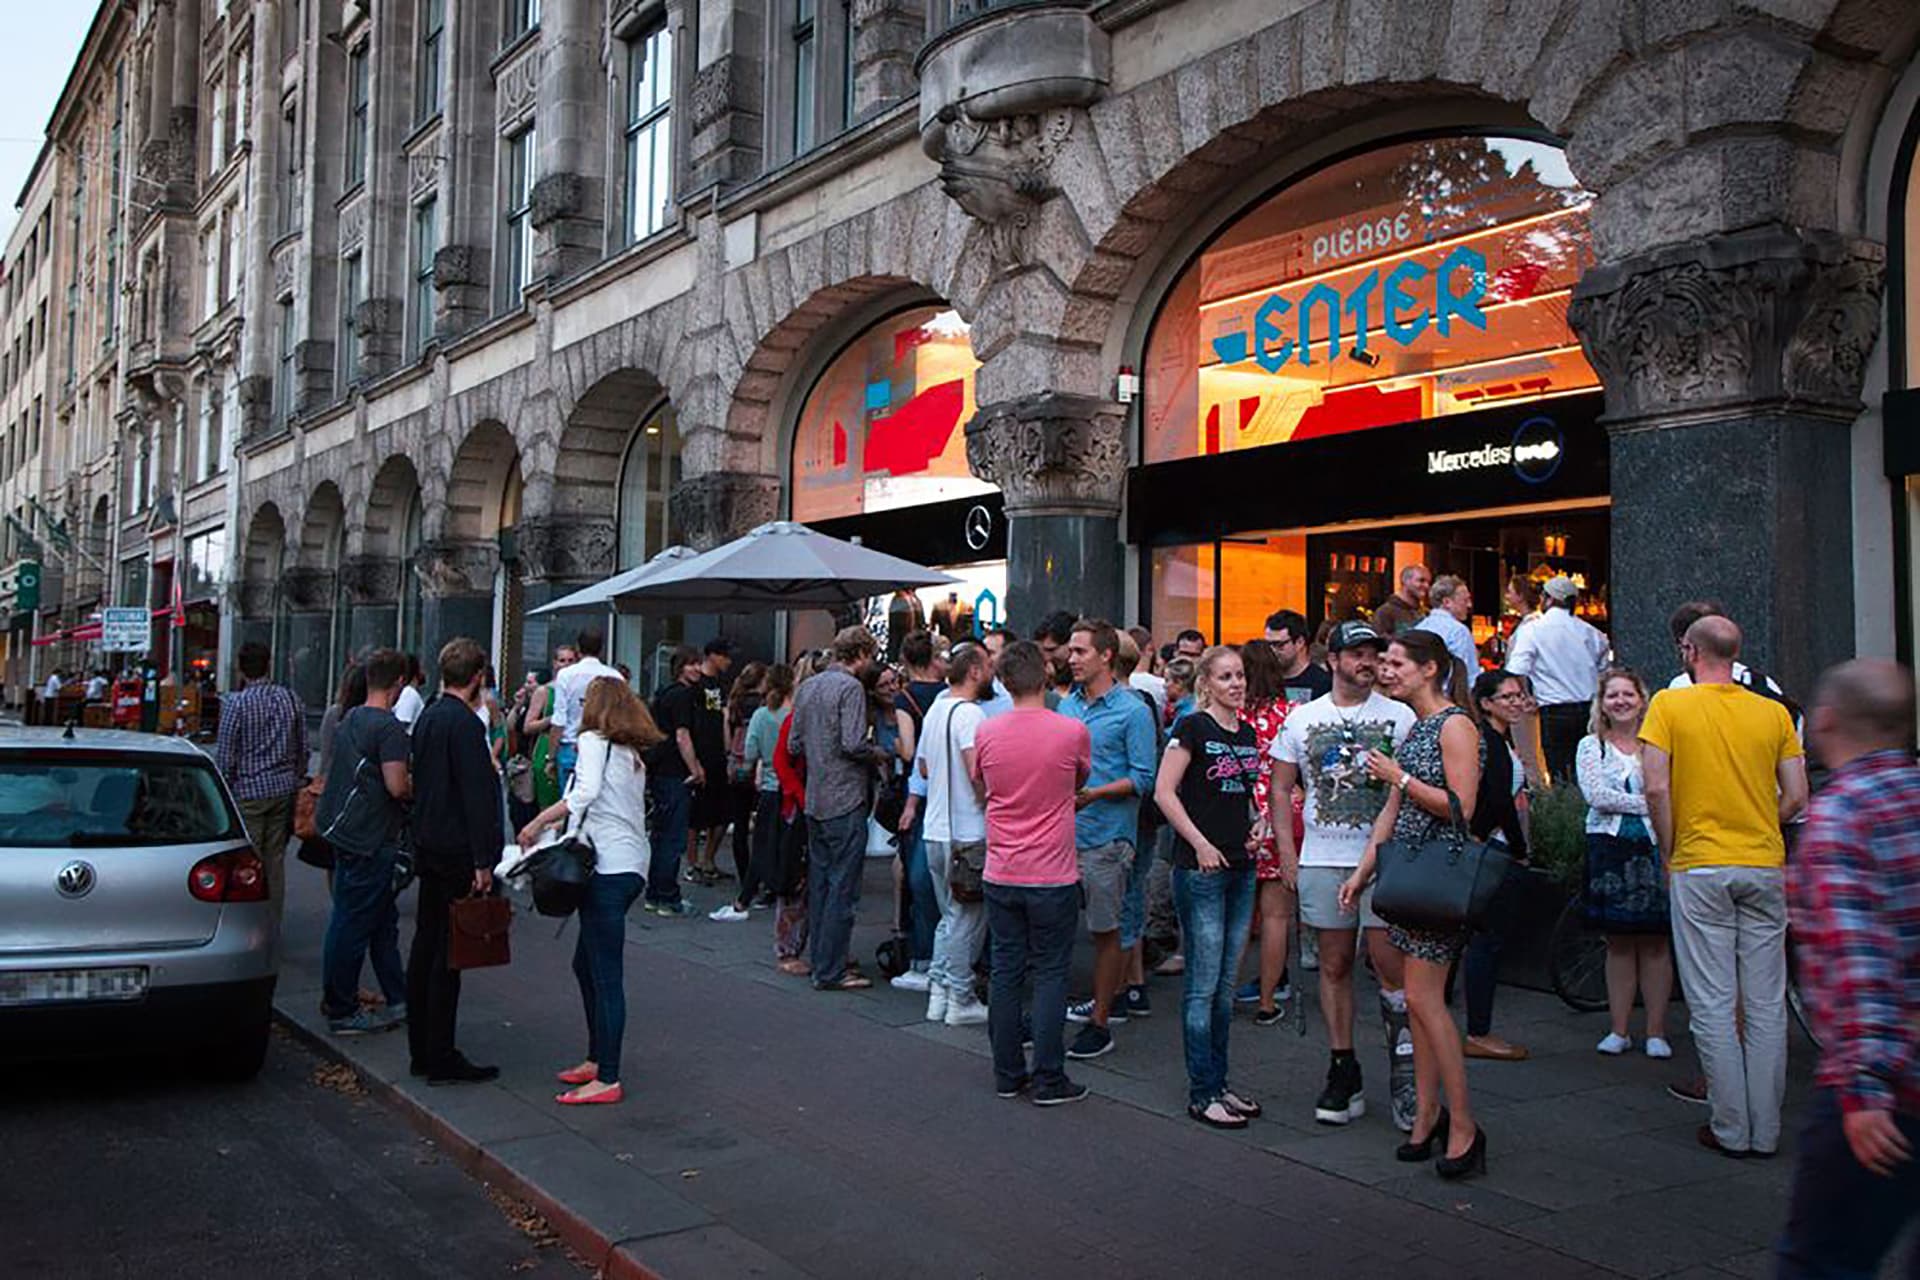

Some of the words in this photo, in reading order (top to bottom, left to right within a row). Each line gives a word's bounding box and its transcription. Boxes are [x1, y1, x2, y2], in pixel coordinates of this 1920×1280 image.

[1312, 212, 1411, 264] PLEASE
[1253, 245, 1487, 374] ENTER
[1428, 443, 1512, 474] Mercedes
